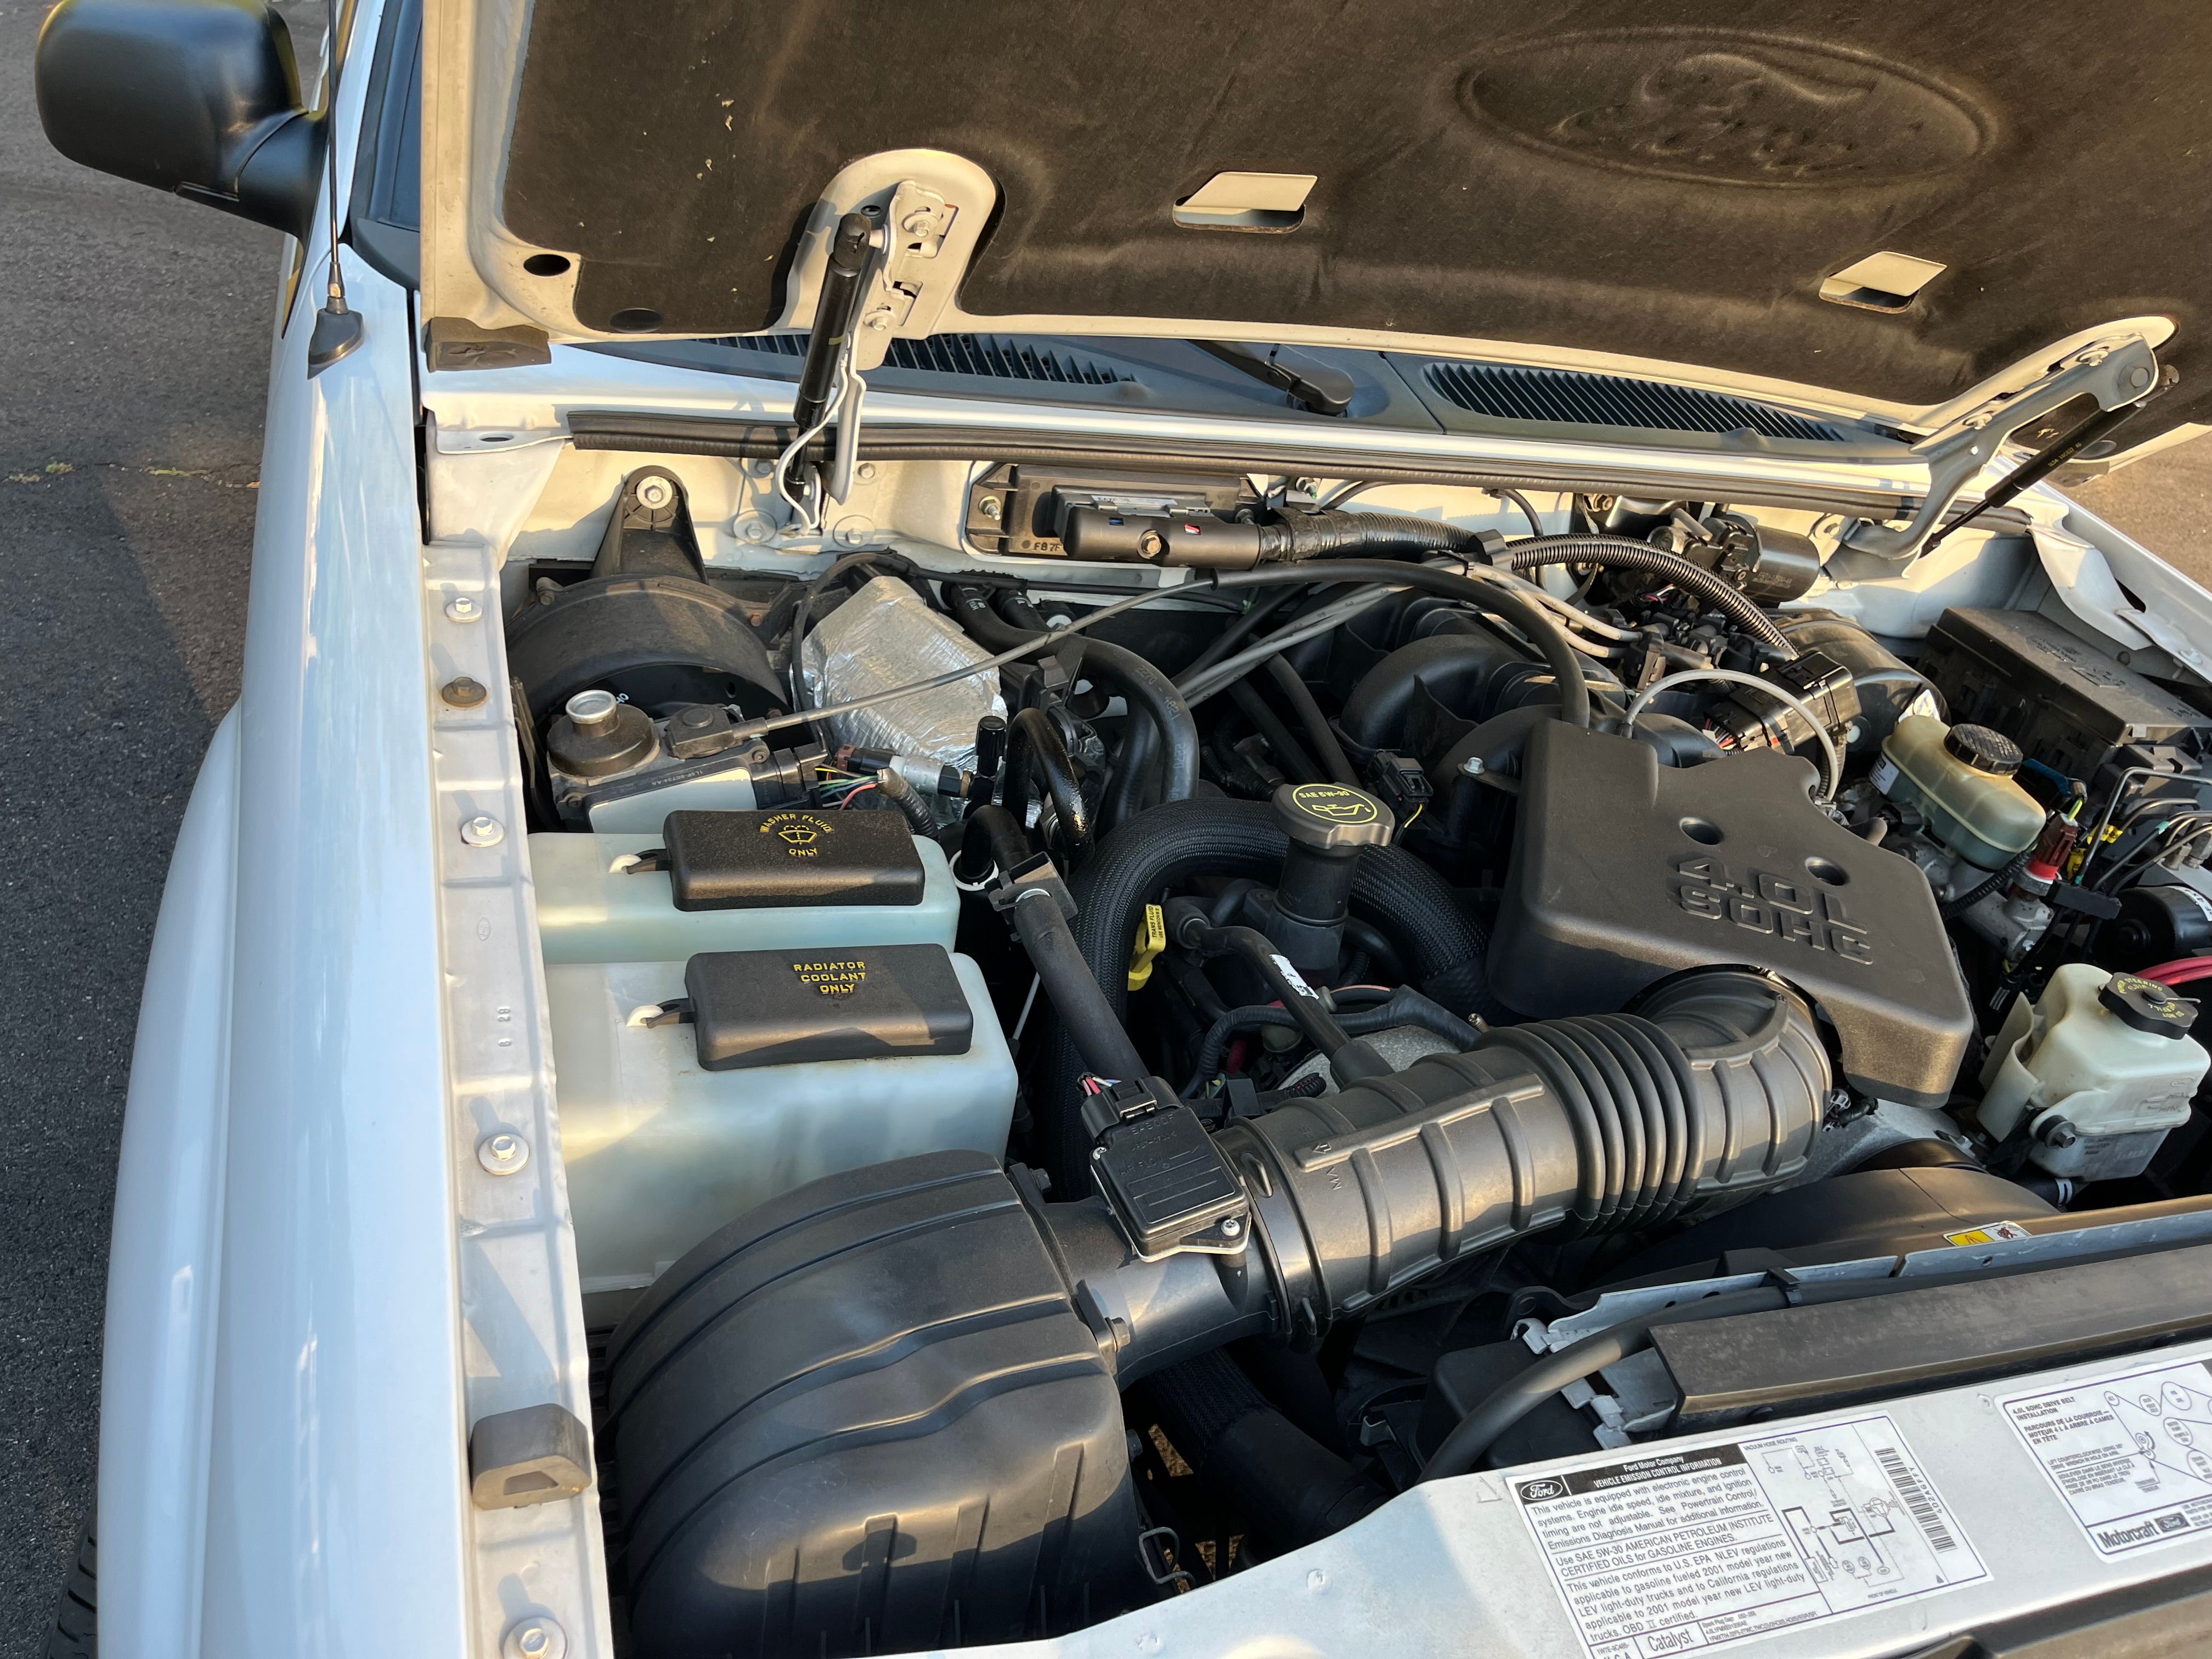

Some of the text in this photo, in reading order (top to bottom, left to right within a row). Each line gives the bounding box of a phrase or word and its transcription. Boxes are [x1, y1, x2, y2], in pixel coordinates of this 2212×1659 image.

[760, 813, 832, 833] WASHER FLUID
[788, 848, 817, 856] ONLY
[1679, 857, 1867, 935] 4.0L
[1680, 885, 1874, 966] SOHC
[793, 961, 866, 972] RADIATOR
[801, 973, 866, 983] COOLANT
[820, 983, 855, 994] ONLY
[2016, 1407, 2059, 1421] INSTALLATION
[2025, 1403, 2043, 1412] SOHC
[2041, 1400, 2062, 1408] DRIVE
[2060, 1396, 2076, 1404] BELT
[2023, 1420, 2056, 1432] PARCOURS
[2073, 1409, 2104, 1421] COURROIE
[2026, 1426, 2055, 1438] MOTEUR
[2058, 1424, 2064, 1432] L
[2067, 1418, 2090, 1430] ARBRE
[2094, 1414, 2115, 1424] CAMES
[1742, 1442, 1764, 1452] VACUUM
[1775, 1436, 1798, 1446] ROUTING
[1593, 1457, 1723, 1488] VEHICLE EMISSION CONTROL INFORMATION
[1622, 1455, 1685, 1472] Ford Motor Company
[1526, 1481, 1558, 1499] Ford
[1531, 1467, 1746, 1515] This vehicle is equipped with electronic engine control
[1537, 1479, 1753, 1528] systems. Engine idle speed, idle mixture, and ignition
[1542, 1488, 1757, 1538] timing are not adjustable. See Powertrain Control/
[1547, 1501, 1764, 1550] Emissions Diagnosis Manual for additional information.
[1555, 1514, 1774, 1566] Use SAE 5W-30 AMERICAN PETROLEUM INSTITUTE
[2097, 1521, 2160, 1548] Motorcraft
[1561, 1533, 1738, 1577] CERTIFIED OILS for GASOLINE ENGINES.
[1566, 1540, 1786, 1593] This vehicle conforms to U.S. EPA NLEV regulations
[1573, 1551, 1792, 1606] applicable to gasoline fueled 2001 model year new
[1578, 1604, 1598, 1617] LEV
[1600, 1596, 1644, 1613] light-duty
[1645, 1589, 1675, 1602] trucks
[1677, 1583, 1695, 1595] and
[1695, 1583, 1706, 1591] to
[1707, 1572, 1751, 1588] California
[1751, 1562, 1799, 1578] regulations
[1584, 1573, 1805, 1631] applicable to 2001 model year new LEV light-duty
[1589, 1610, 1699, 1642] trucks. OBD II certified.
[1646, 1628, 1695, 1652] Catalyst
